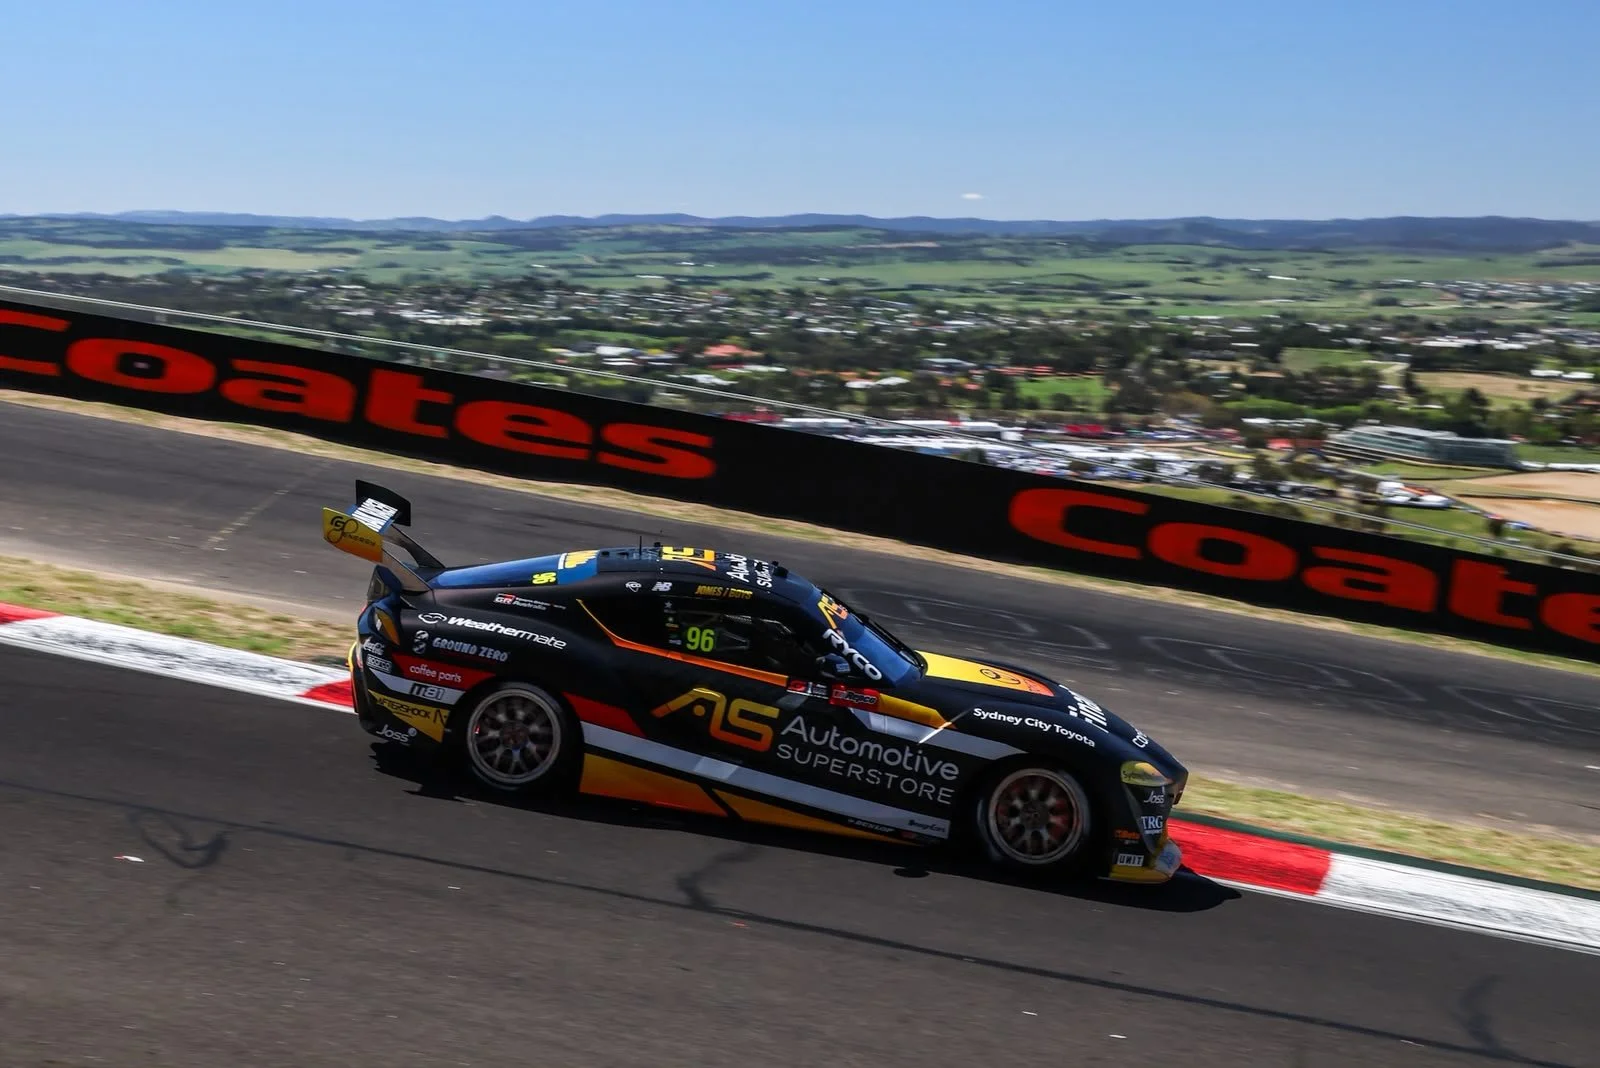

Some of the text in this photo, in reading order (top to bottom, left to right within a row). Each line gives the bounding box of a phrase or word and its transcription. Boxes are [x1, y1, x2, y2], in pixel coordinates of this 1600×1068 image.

[448, 616, 567, 650] Weathermate
[686, 626, 715, 652] 96
[432, 637, 509, 663] GROUND ZERO
[409, 664, 462, 682] coffee parts
[846, 690, 878, 704] Repco
[973, 708, 1096, 748] Sydney City Toyota
[780, 716, 960, 780] Automotive
[776, 743, 955, 805] SUPERSTORE
[1141, 815, 1163, 830] TRG
